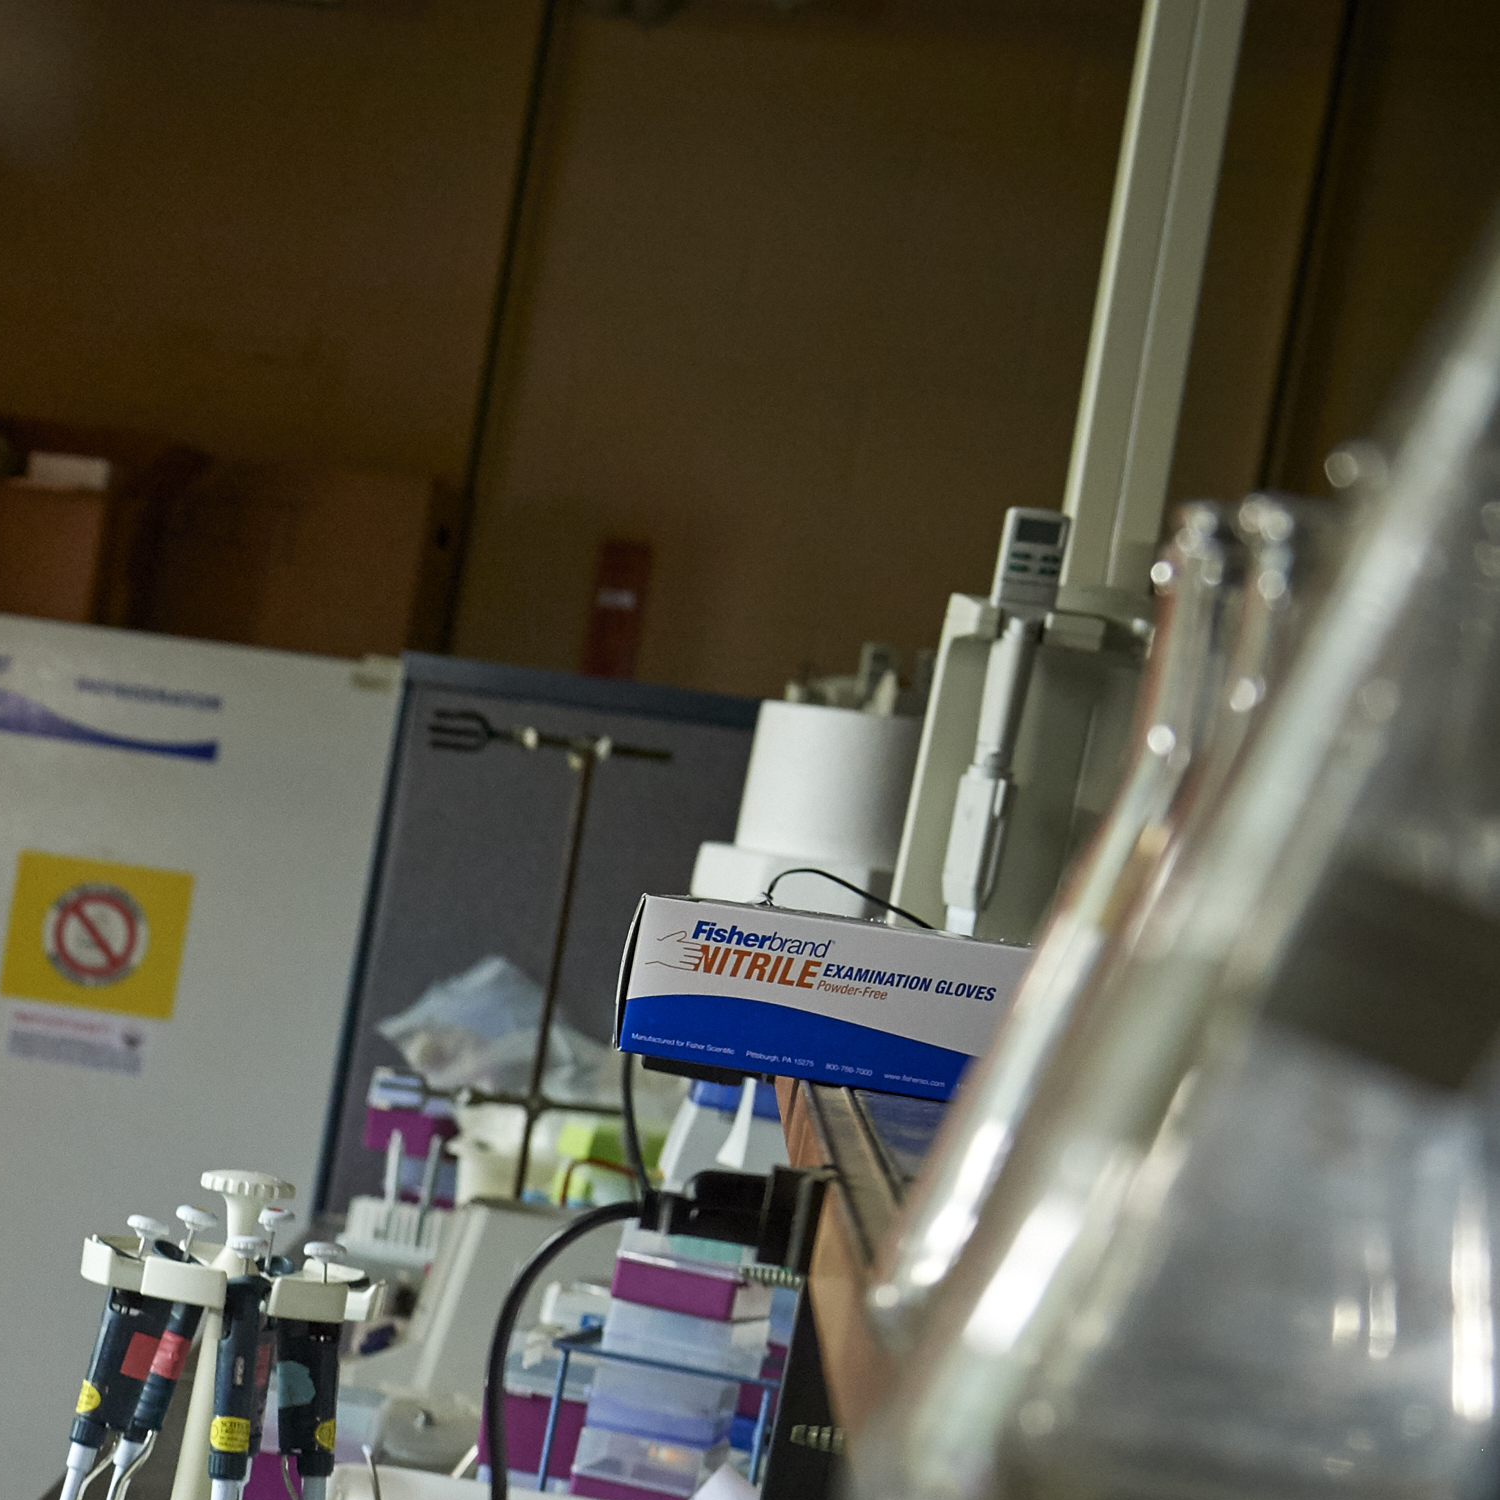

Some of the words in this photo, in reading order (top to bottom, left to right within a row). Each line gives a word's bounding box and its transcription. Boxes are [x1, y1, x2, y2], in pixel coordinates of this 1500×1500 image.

[693, 943, 823, 989] NITRILE
[823, 963, 933, 992] EXAMINATION
[934, 980, 997, 1002] GLOVES
[816, 980, 888, 1001] Powder-Free
[631, 1032, 675, 1046] Manufactured
[781, 1055, 792, 1064] PA
